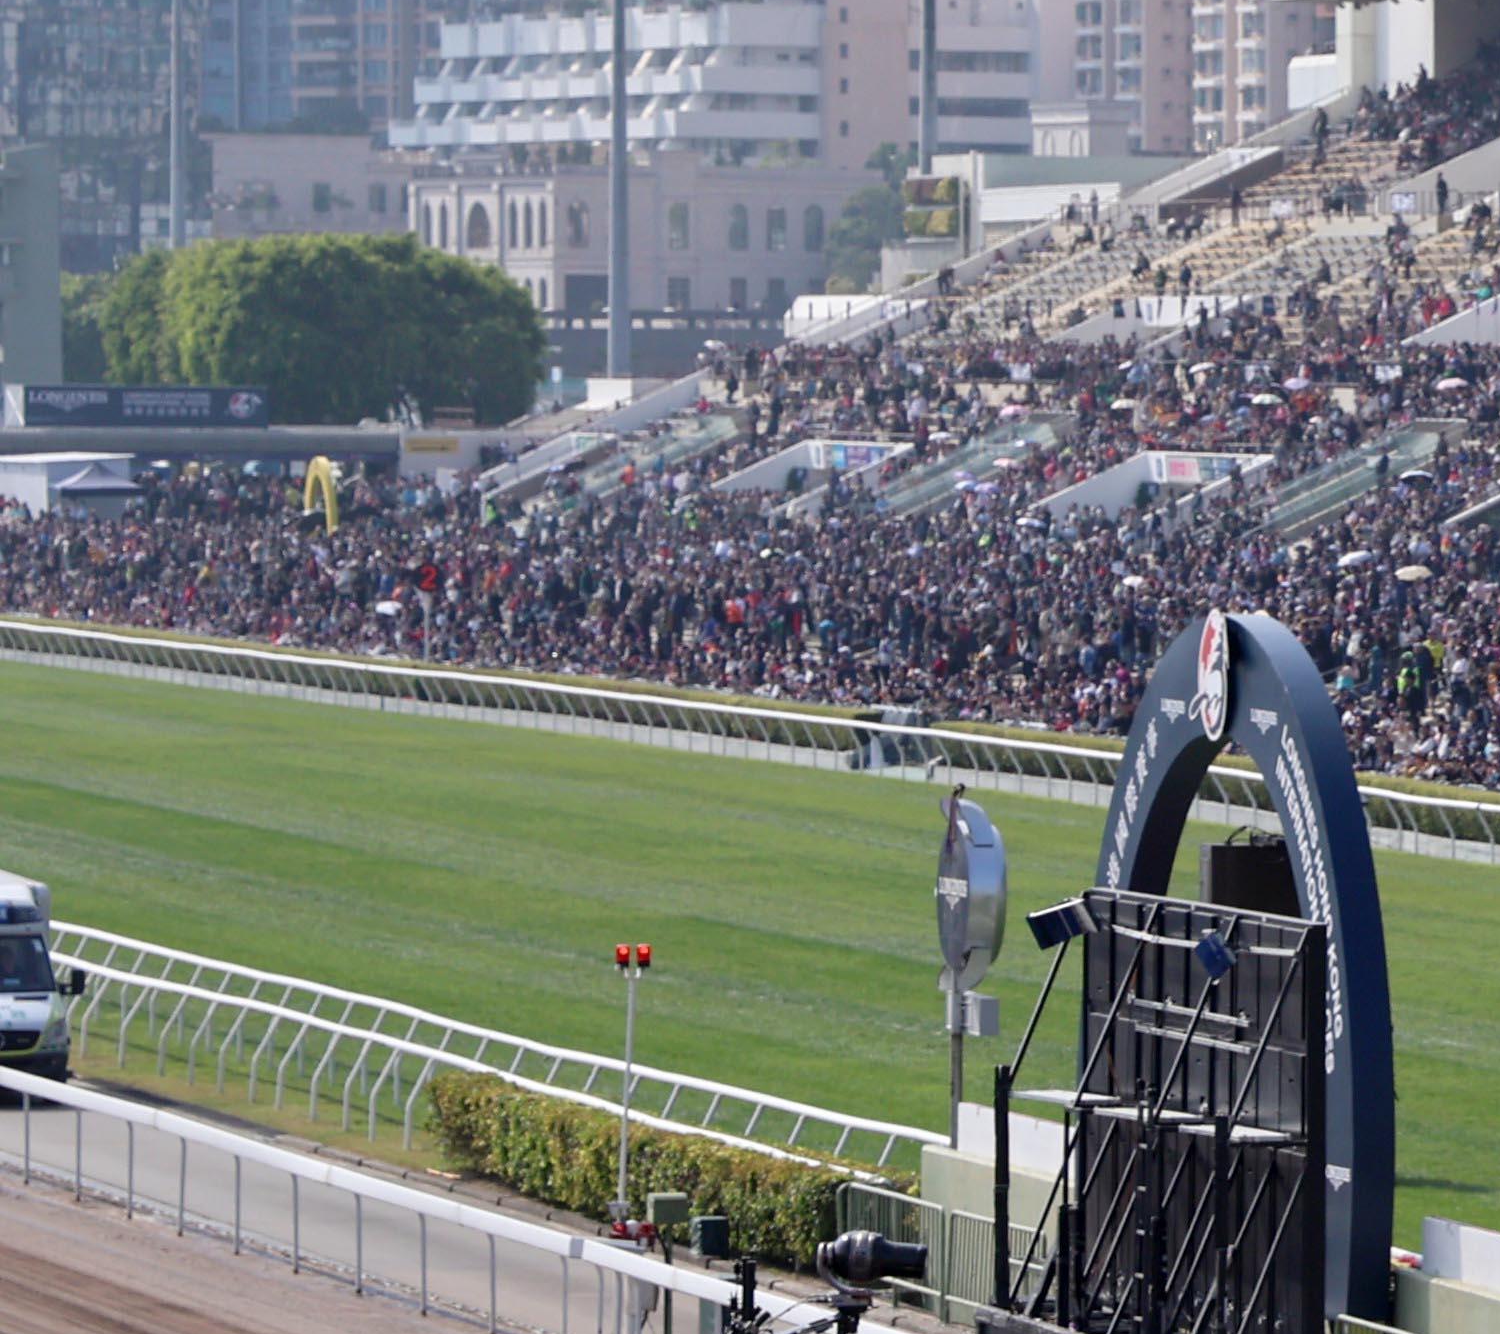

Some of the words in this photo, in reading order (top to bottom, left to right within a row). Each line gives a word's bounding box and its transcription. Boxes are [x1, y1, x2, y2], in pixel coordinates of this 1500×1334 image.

[421, 566, 437, 589] 2
[1281, 724, 1319, 848] LONGINES
[1326, 941, 1343, 1039] KONG
